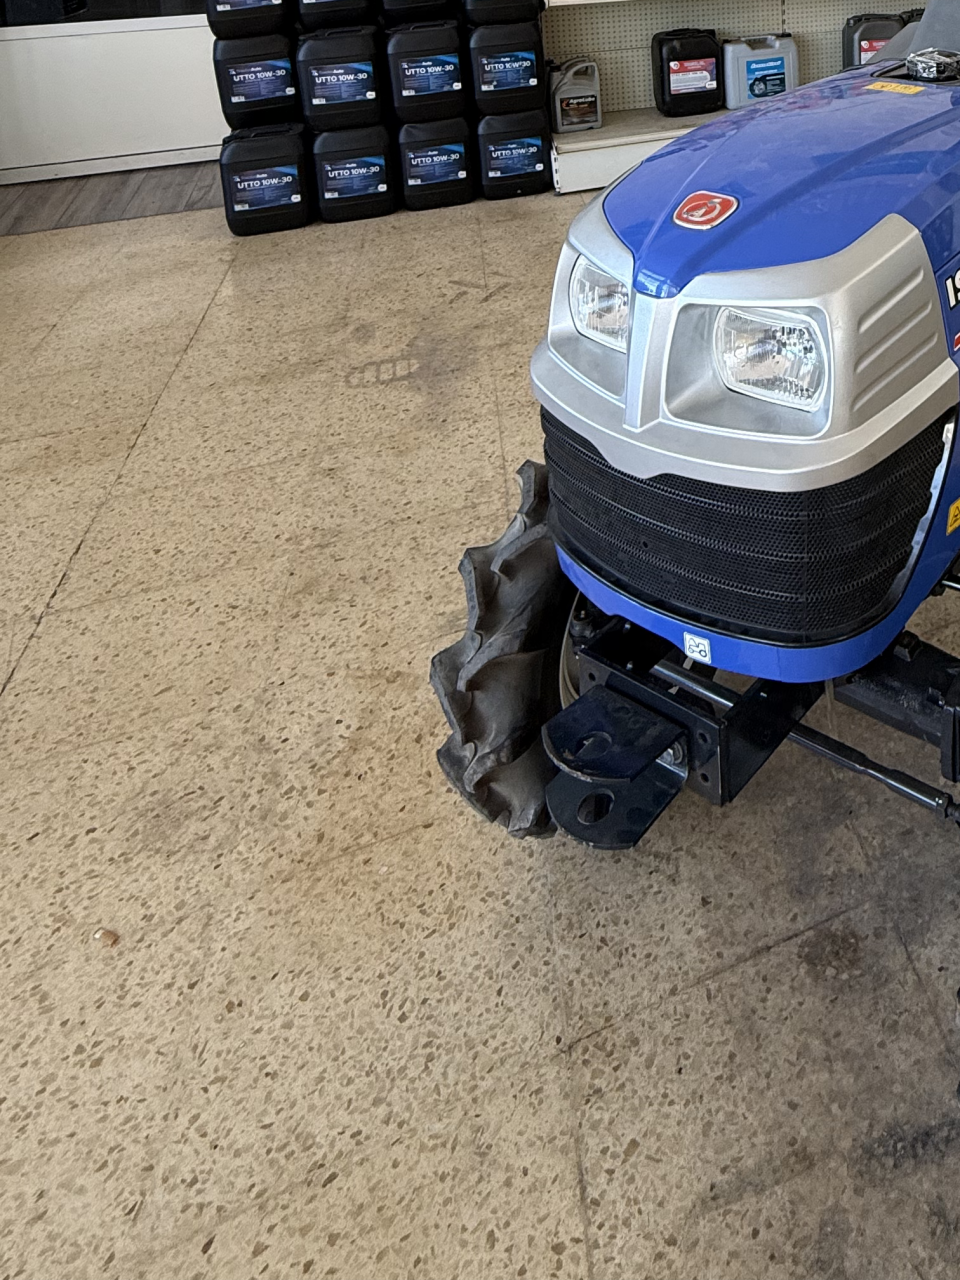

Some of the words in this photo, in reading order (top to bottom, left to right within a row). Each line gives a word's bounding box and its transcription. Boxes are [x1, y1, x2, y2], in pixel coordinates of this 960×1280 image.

[405, 67, 426, 76] UTTO
[427, 64, 454, 73] 10W-30
[485, 62, 504, 71] UTTO
[233, 73, 255, 82] UTTO
[256, 69, 286, 79] 10W-30
[315, 75, 338, 84] UTTO
[338, 72, 367, 81] 10W-30
[411, 156, 432, 165] UTTO
[433, 153, 460, 162] 10W-30
[491, 150, 511, 158] UTTO
[328, 169, 350, 178] UTTO
[351, 166, 380, 175] 10W-30
[237, 180, 261, 189] UTTO
[261, 176, 293, 186] 10W-30
